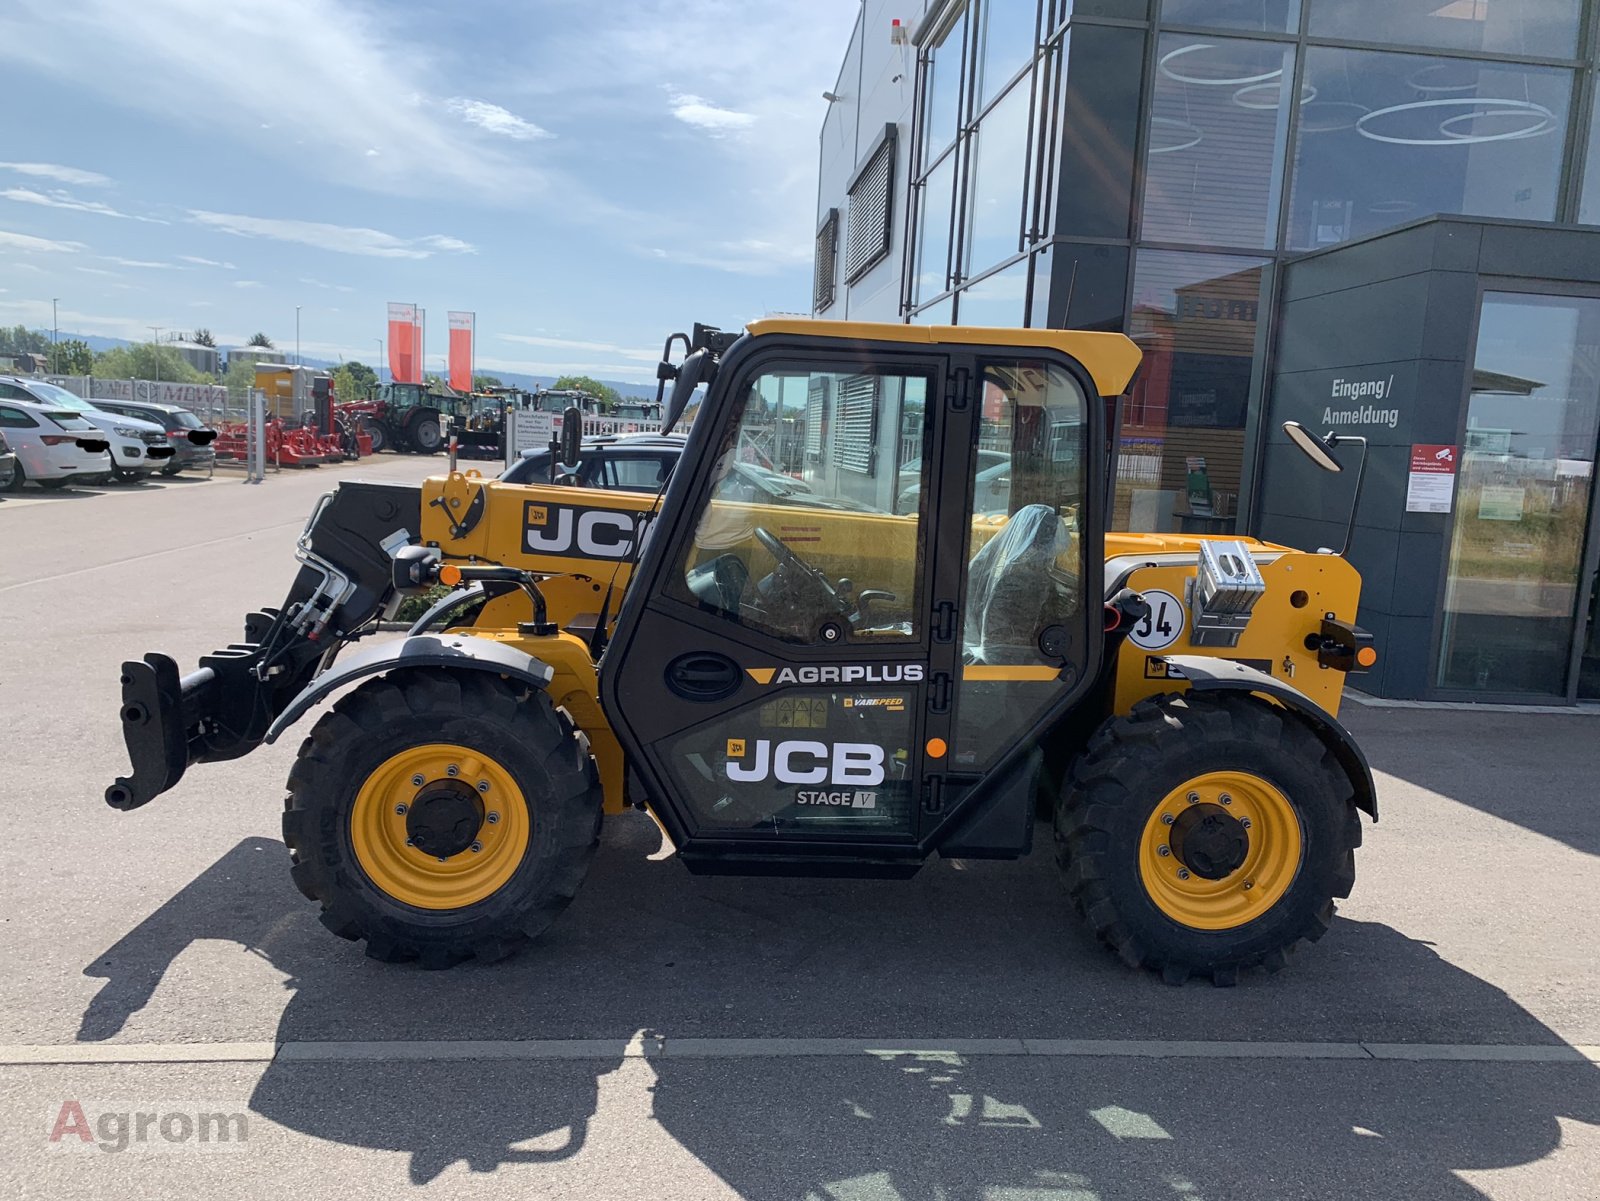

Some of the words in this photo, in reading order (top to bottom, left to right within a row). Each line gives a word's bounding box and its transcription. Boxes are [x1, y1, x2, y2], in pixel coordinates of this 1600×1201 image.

[1321, 405, 1399, 428] Anmeldung
[1136, 601, 1172, 638] 34
[775, 664, 924, 684] AGRIPLUS
[725, 739, 885, 786] JCB
[797, 791, 851, 806] STAGE
